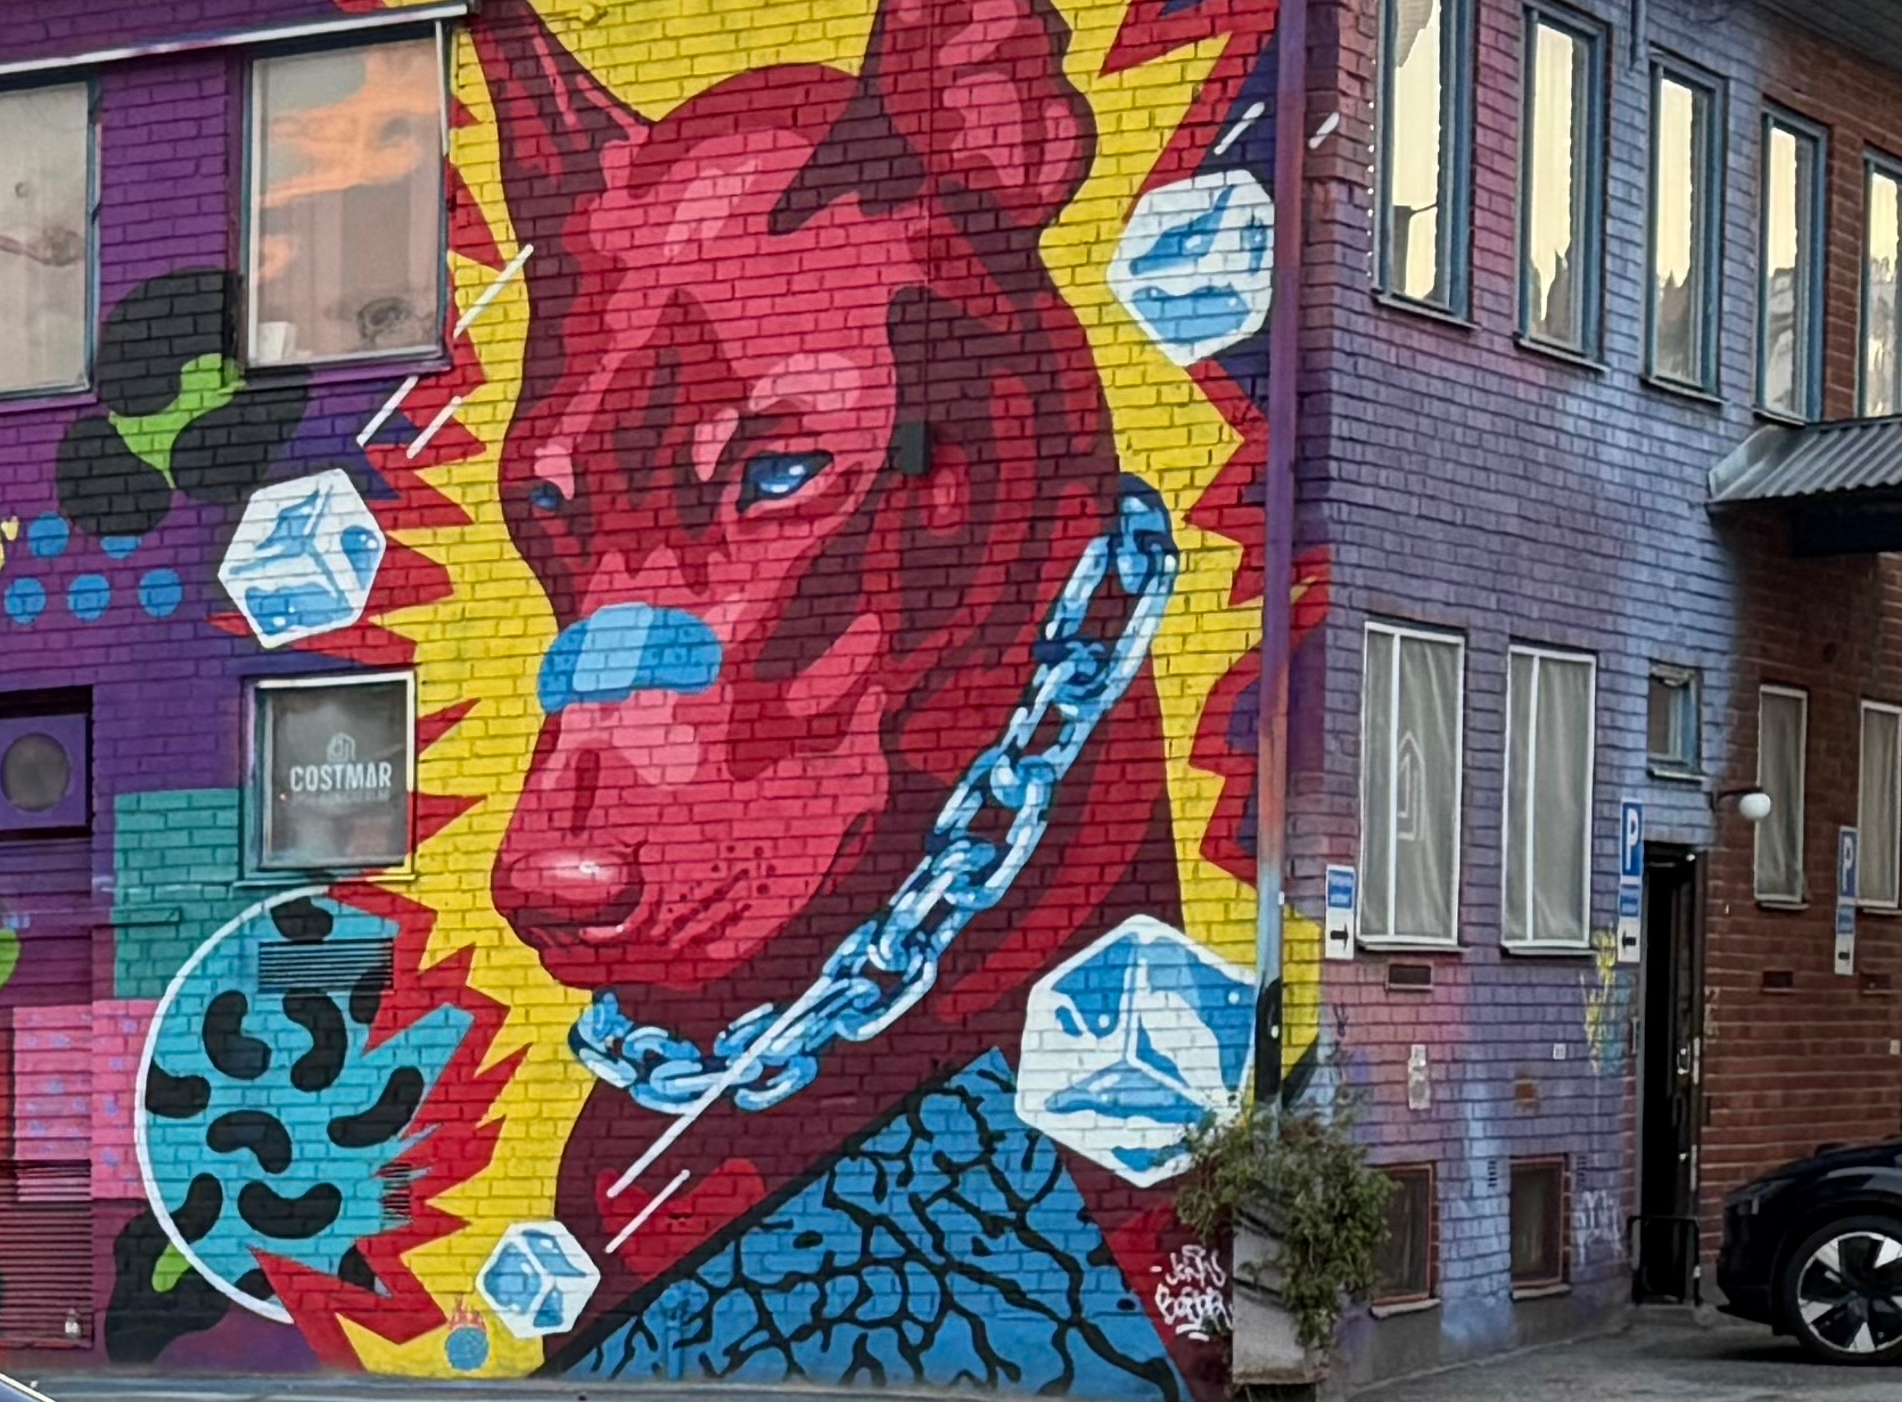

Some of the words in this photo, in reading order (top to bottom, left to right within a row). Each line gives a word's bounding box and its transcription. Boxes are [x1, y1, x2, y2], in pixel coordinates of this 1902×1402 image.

[289, 760, 393, 792] COSTMAR
[1625, 807, 1639, 871] P
[1842, 835, 1854, 893] P
